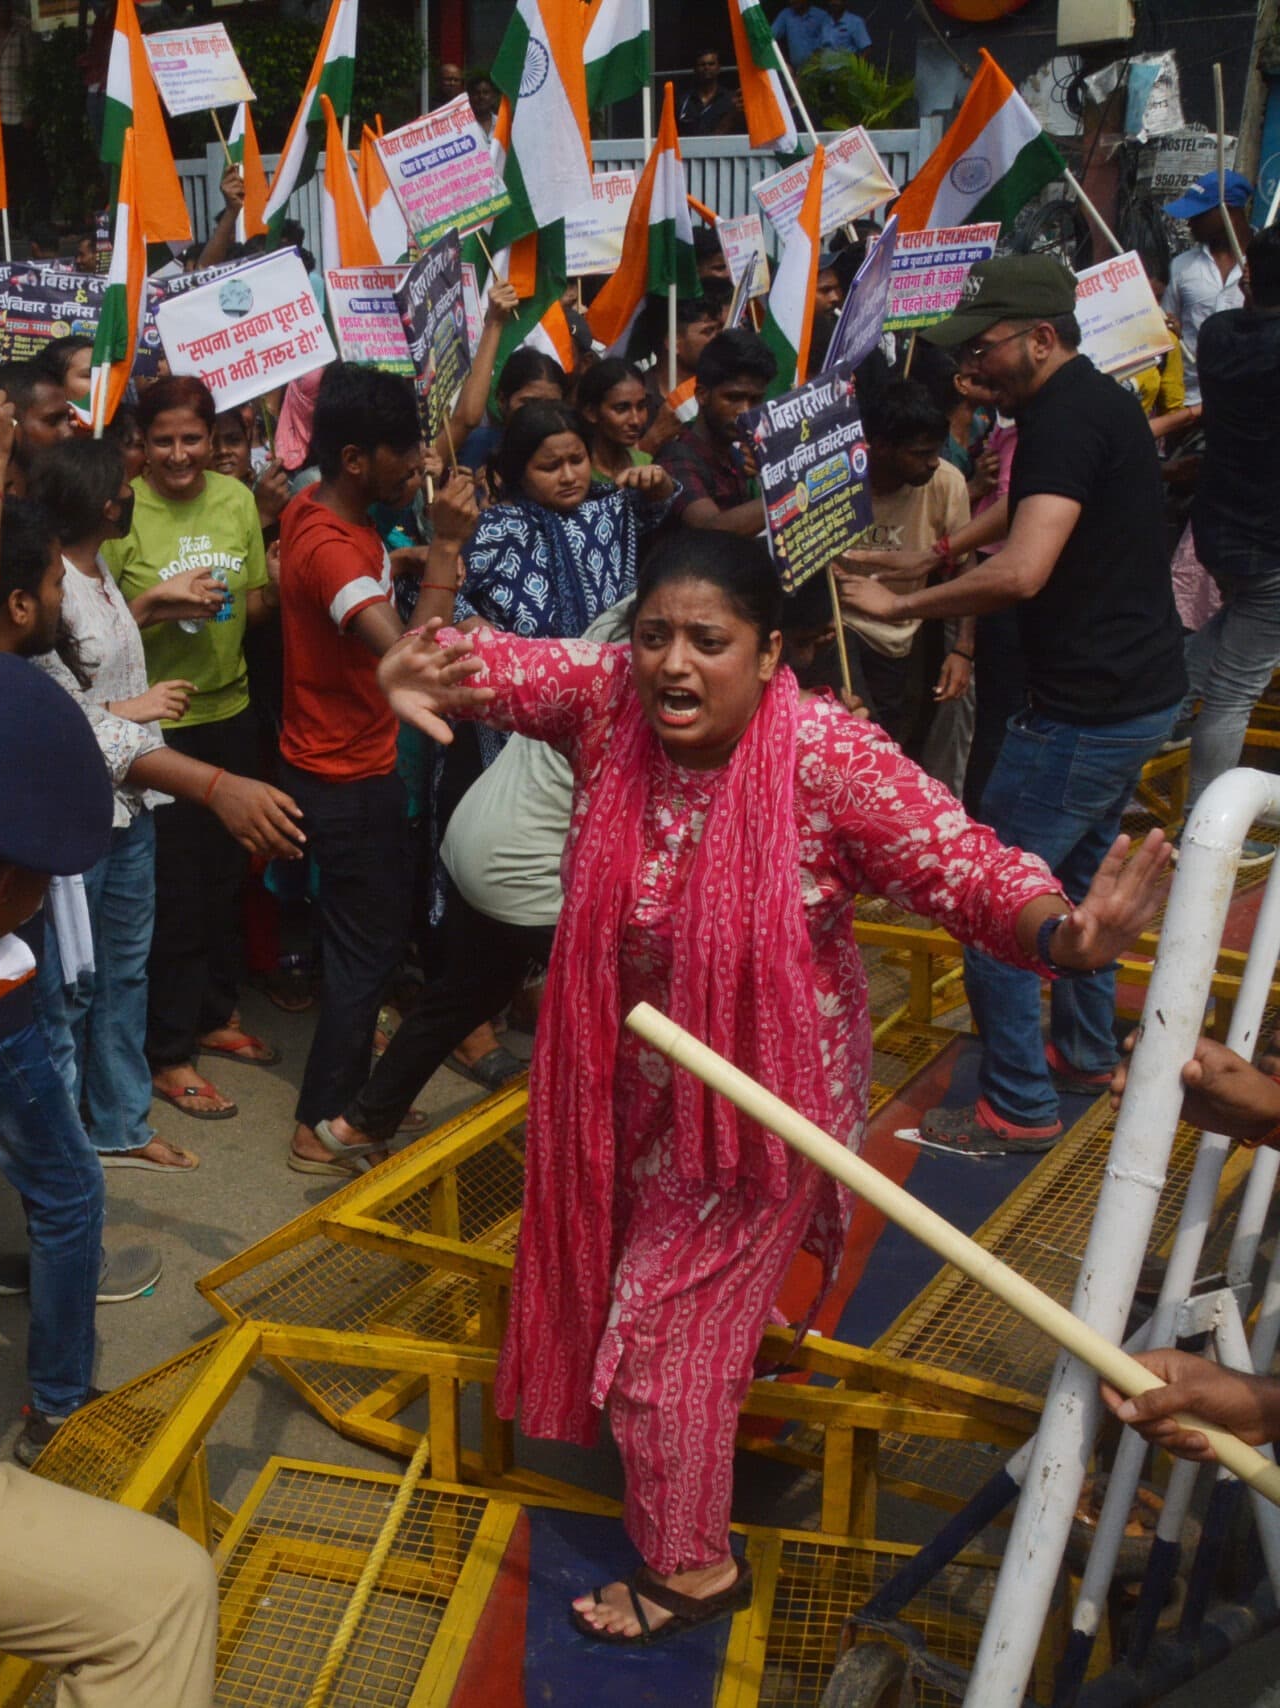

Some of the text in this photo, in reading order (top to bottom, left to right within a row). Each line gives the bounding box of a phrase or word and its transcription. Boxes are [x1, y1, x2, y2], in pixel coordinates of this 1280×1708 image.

[605, 175, 632, 205] पुलिस
[39, 267, 87, 291] बिहार
[327, 270, 396, 290] बिहार दारोगा
[1102, 258, 1141, 293] पुलिस
[7, 295, 96, 320] बिहार पुलिस
[75, 289, 88, 304] &
[902, 295, 922, 313] पहले
[230, 312, 274, 344] सबका
[272, 300, 300, 334] पूरा
[297, 291, 315, 315] हो
[228, 349, 259, 383] भर्ती
[766, 382, 834, 433] बिहार दरोगा
[800, 418, 810, 442] &
[760, 458, 787, 490] बिहार
[787, 443, 817, 482] पुलिस
[816, 419, 865, 457] कांस्टेबल
[179, 535, 212, 557] Skate
[158, 552, 243, 581] BOARDING
